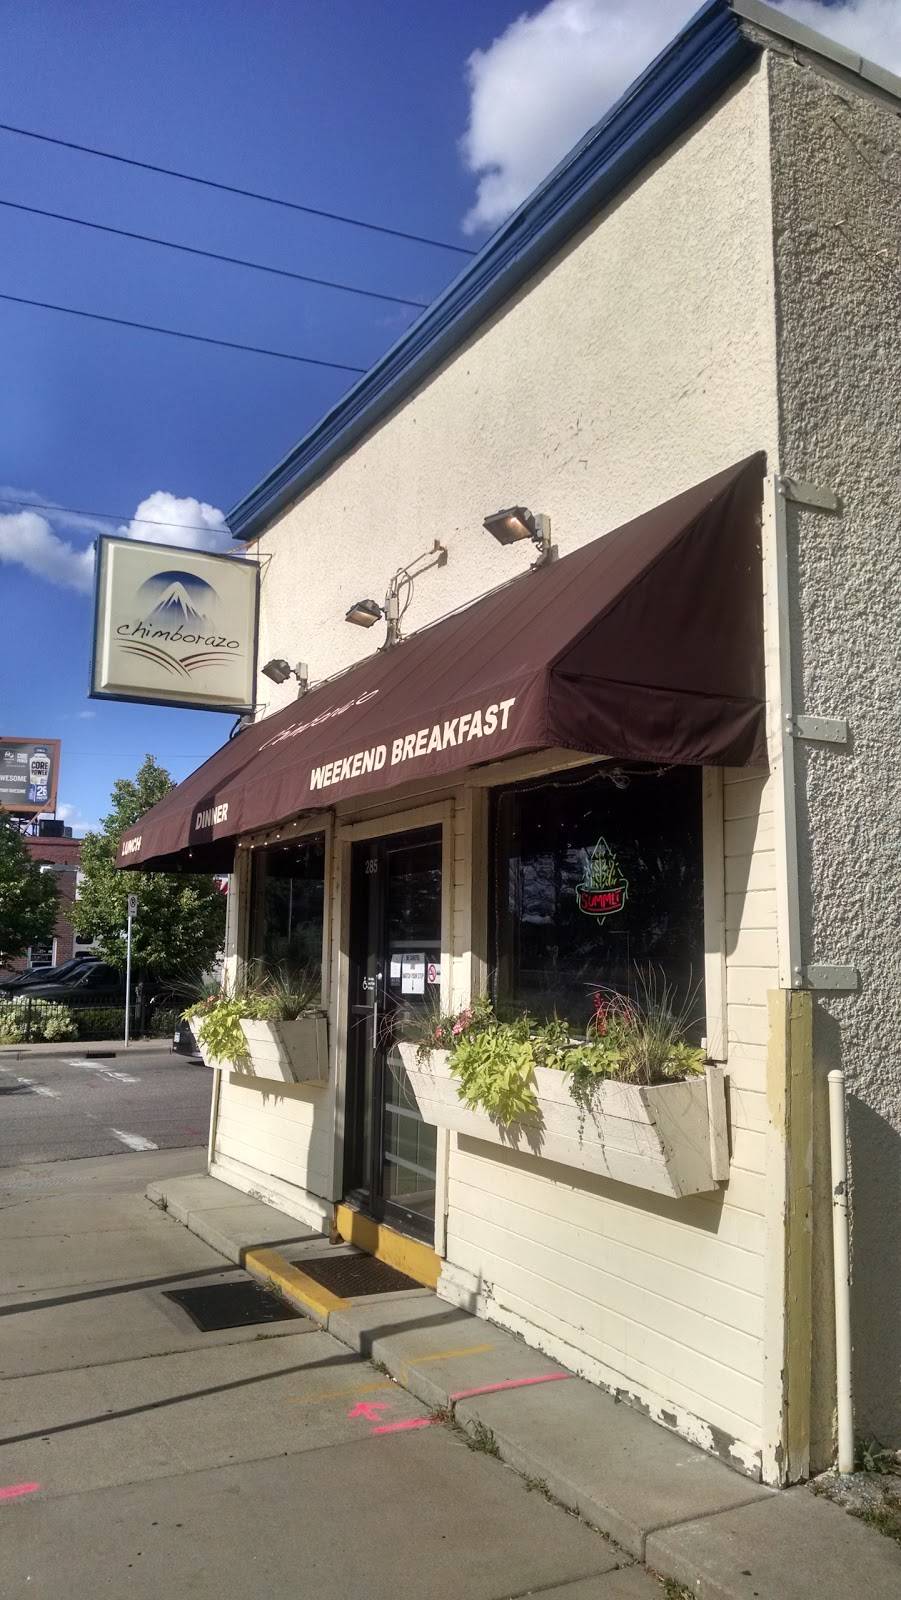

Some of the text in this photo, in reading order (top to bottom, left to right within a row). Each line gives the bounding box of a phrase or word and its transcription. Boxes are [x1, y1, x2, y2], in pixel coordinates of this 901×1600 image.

[309, 744, 387, 790] WEEKEND
[391, 697, 516, 766] BREAKFAST
[31, 761, 48, 770] CORE
[195, 802, 229, 831] DINNER
[121, 835, 142, 857] LUNCH
[364, 858, 378, 875] 285
